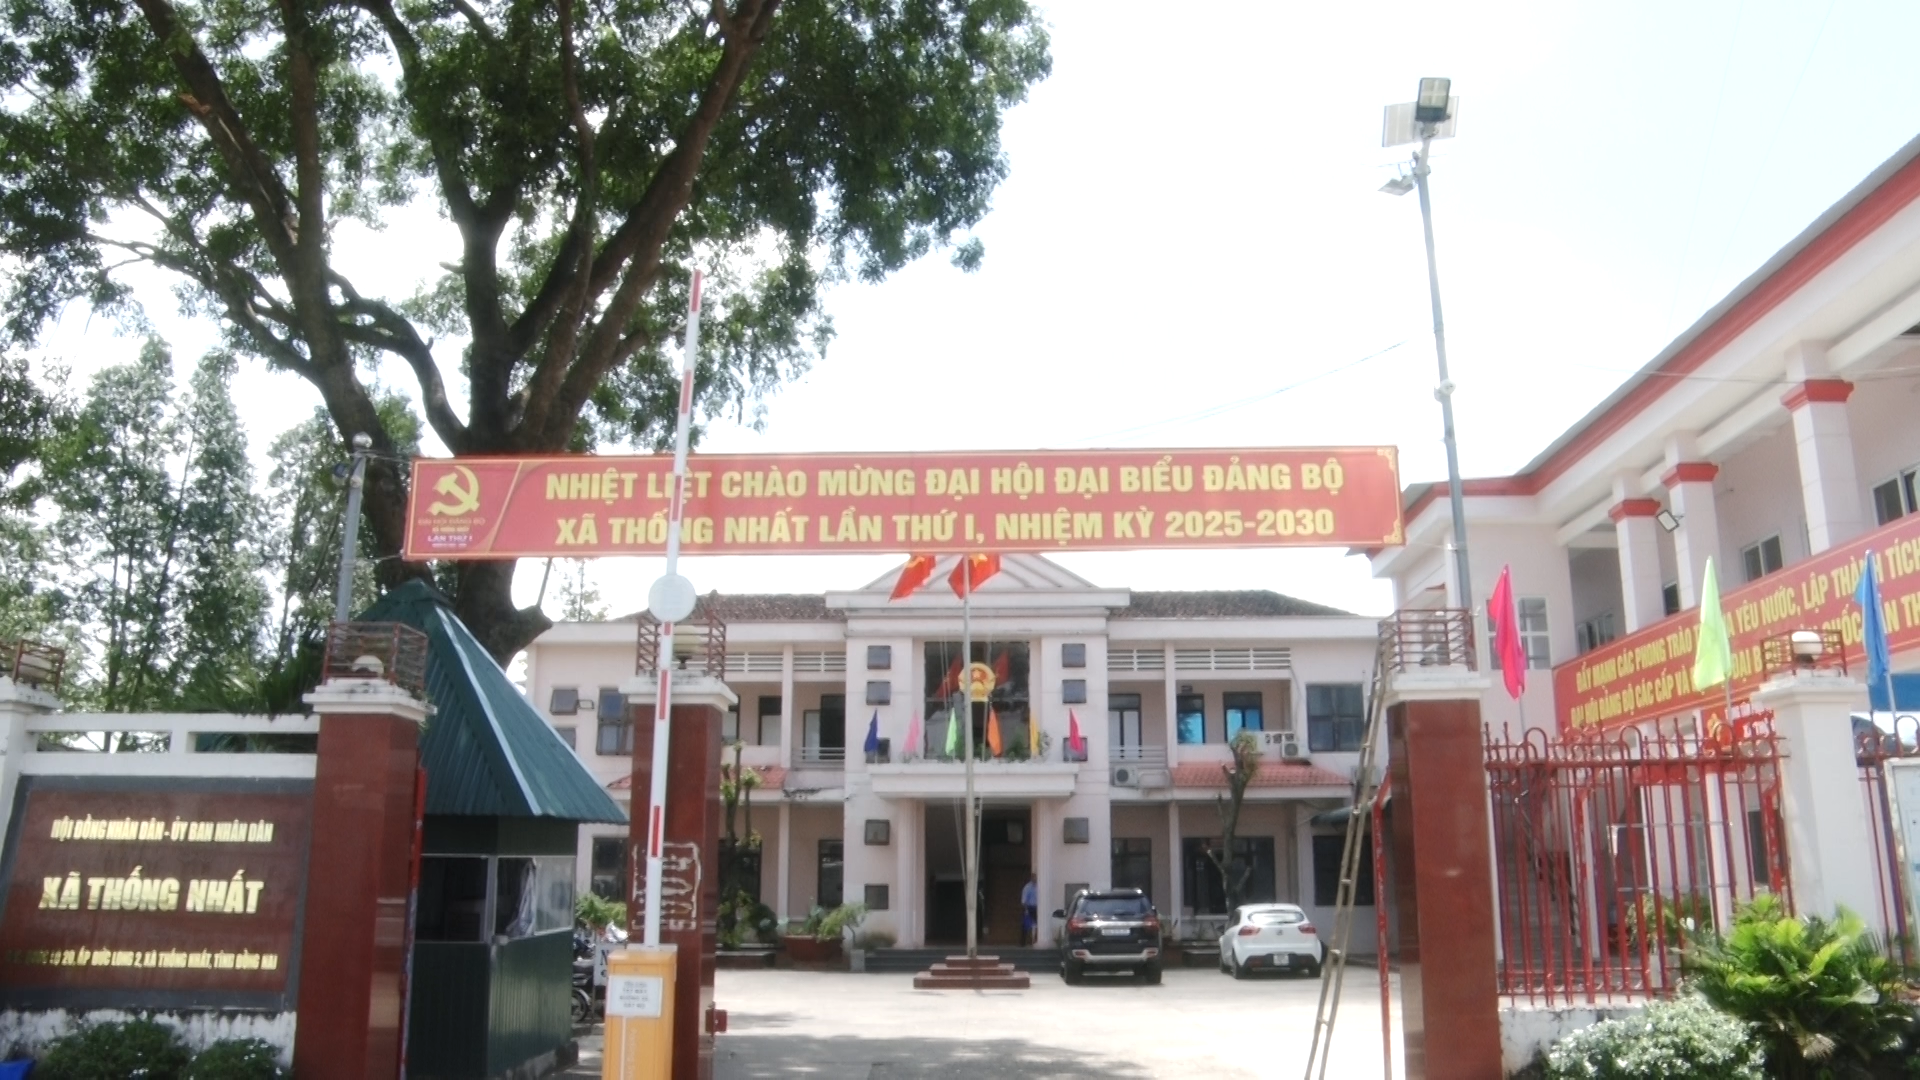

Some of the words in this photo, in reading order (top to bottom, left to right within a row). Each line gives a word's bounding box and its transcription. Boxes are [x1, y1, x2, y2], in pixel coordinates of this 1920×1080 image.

[546, 467, 638, 504] NHIỆT
[721, 466, 808, 498] CHÀO
[818, 463, 915, 497] MỪNG
[925, 467, 980, 500] ĐẠI
[991, 461, 1045, 500] HỘI
[1054, 466, 1109, 499] ĐẠI
[1120, 455, 1194, 493] BIỂU
[1203, 455, 1291, 492] ĐẢNG
[1301, 457, 1345, 495] BỘ
[555, 513, 598, 545] XÃ
[724, 507, 809, 545] NHẤT
[819, 507, 883, 543] LẦN
[892, 509, 958, 541] THỨ
[965, 513, 985, 544] I,
[995, 507, 1103, 546] NHIỆM
[1113, 505, 1154, 539] KỲ
[1165, 508, 1336, 538] 2025-2030
[1617, 648, 1635, 678] CÁC
[1666, 626, 1693, 659] TRÀO
[1736, 600, 1760, 634] YÊU
[1802, 571, 1829, 614] LẬP
[1635, 677, 1655, 708] CÁC
[1654, 667, 1675, 703] CẤP
[1674, 665, 1691, 696] VÀ
[51, 815, 74, 842] HỘI
[73, 813, 108, 841] ĐỒNG
[106, 817, 139, 841] NHÂN
[138, 817, 165, 841] DÂN
[188, 821, 215, 842] BAN
[214, 818, 248, 842] NHÂN
[247, 819, 274, 842] DÂN
[38, 871, 81, 910] XÃ
[87, 865, 181, 911] THỐNG
[185, 869, 264, 914] NHẤT
